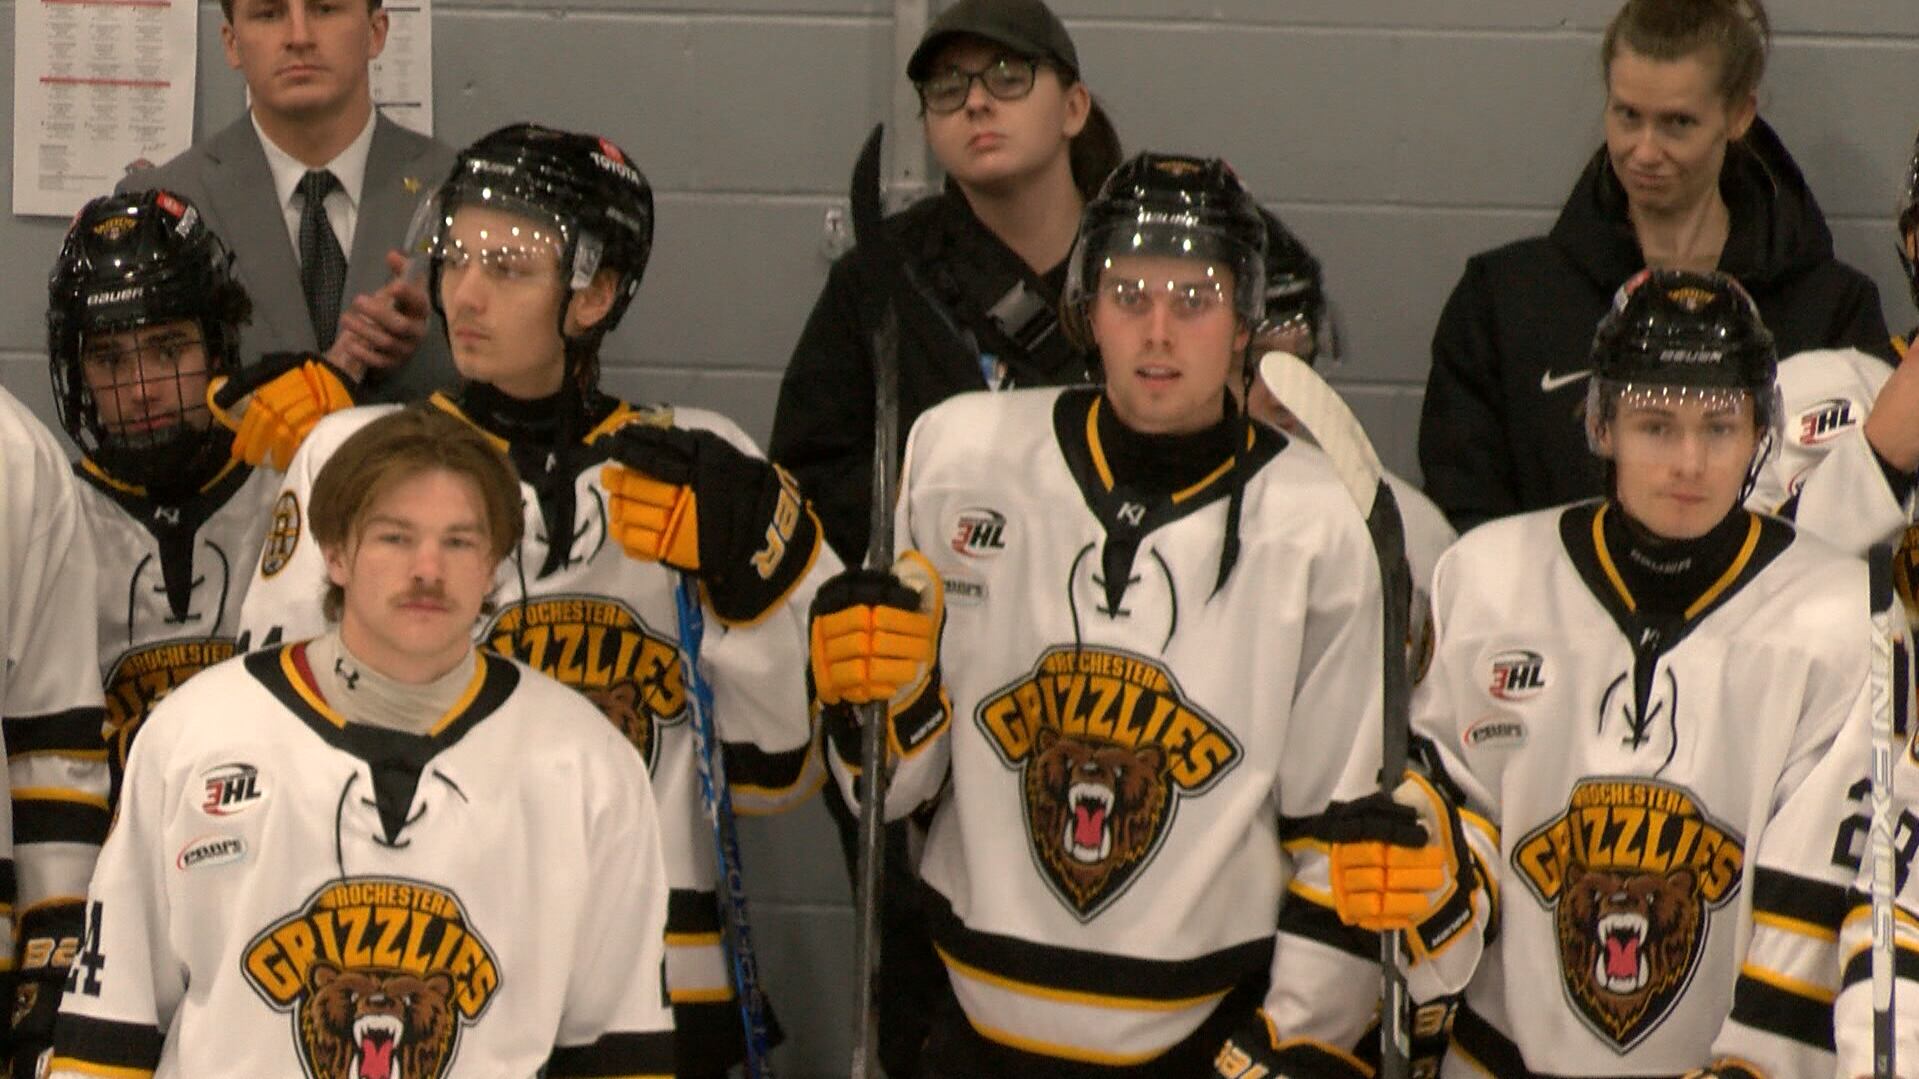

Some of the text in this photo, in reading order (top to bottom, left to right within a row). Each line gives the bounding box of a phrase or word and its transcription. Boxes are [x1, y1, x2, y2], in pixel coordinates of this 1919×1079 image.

[590, 152, 640, 185] TOYOTA
[984, 673, 1234, 788] GRIZZLIES
[334, 883, 447, 916] ROCHESTER
[1517, 806, 1746, 901] GRIZZLIES
[247, 906, 496, 1016] GRIZZLIES
